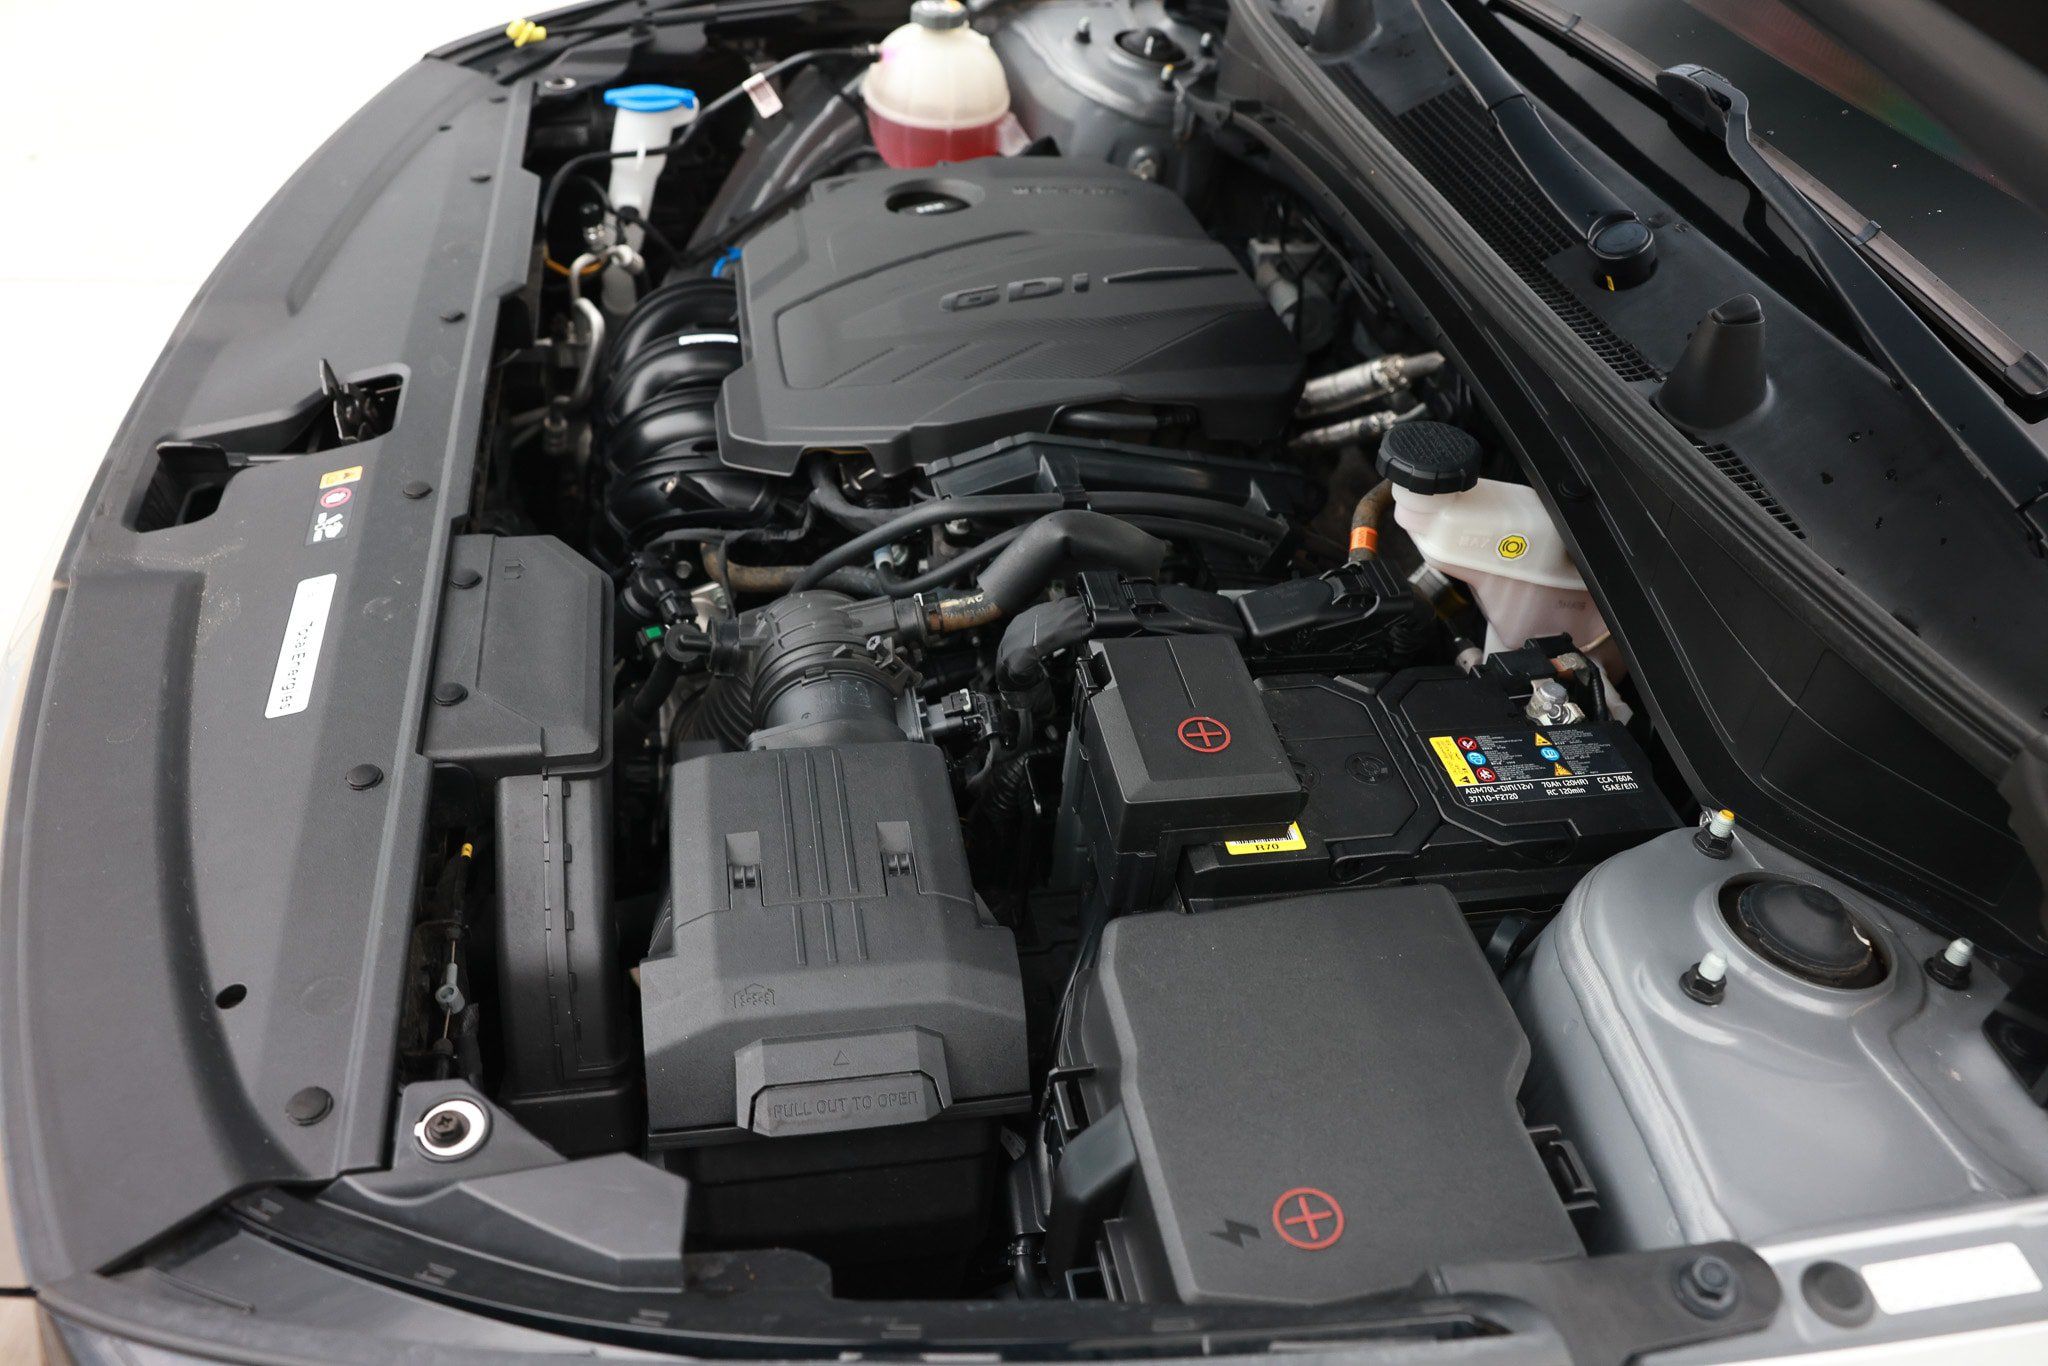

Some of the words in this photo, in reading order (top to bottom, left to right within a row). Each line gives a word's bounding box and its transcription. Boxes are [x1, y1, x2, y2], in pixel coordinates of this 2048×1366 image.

[279, 620, 314, 711] TotaEnergies
[1597, 776, 1614, 784] CCA
[1613, 774, 1634, 783] 760A
[1559, 786, 1586, 795] 120min
[773, 1102, 812, 1119] PULL
[816, 1097, 847, 1115] OUT
[851, 1095, 873, 1111] TO
[877, 1090, 920, 1108] OPEN
